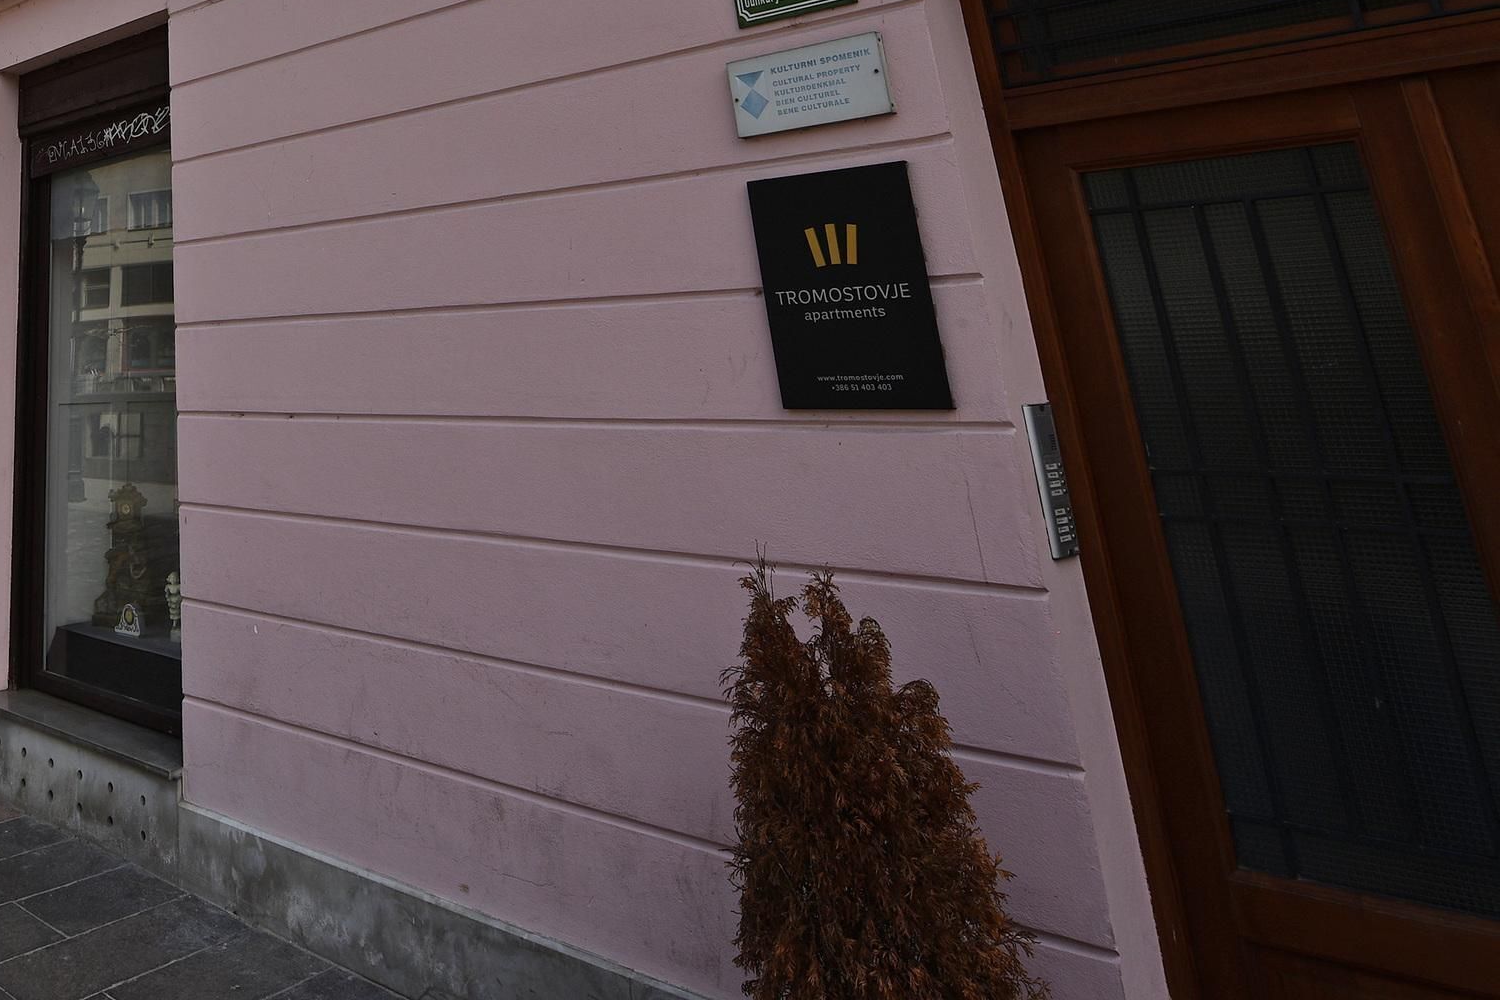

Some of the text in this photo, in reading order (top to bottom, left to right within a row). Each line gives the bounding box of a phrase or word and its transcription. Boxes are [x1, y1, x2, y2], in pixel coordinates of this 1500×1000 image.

[770, 48, 871, 75] KULTURNI SPOMENIK
[773, 64, 861, 87] CULTURAL PROPERTY
[774, 79, 847, 97] KULTURDENKMAL
[776, 90, 840, 107] BIEN CULTUREL
[777, 98, 851, 116] BENE CULTURALE
[775, 282, 911, 305] TROMOSTOVJE
[804, 306, 886, 322] apartments
[818, 373, 904, 382] www.tromostovje.com
[877, 383, 892, 391] 403
